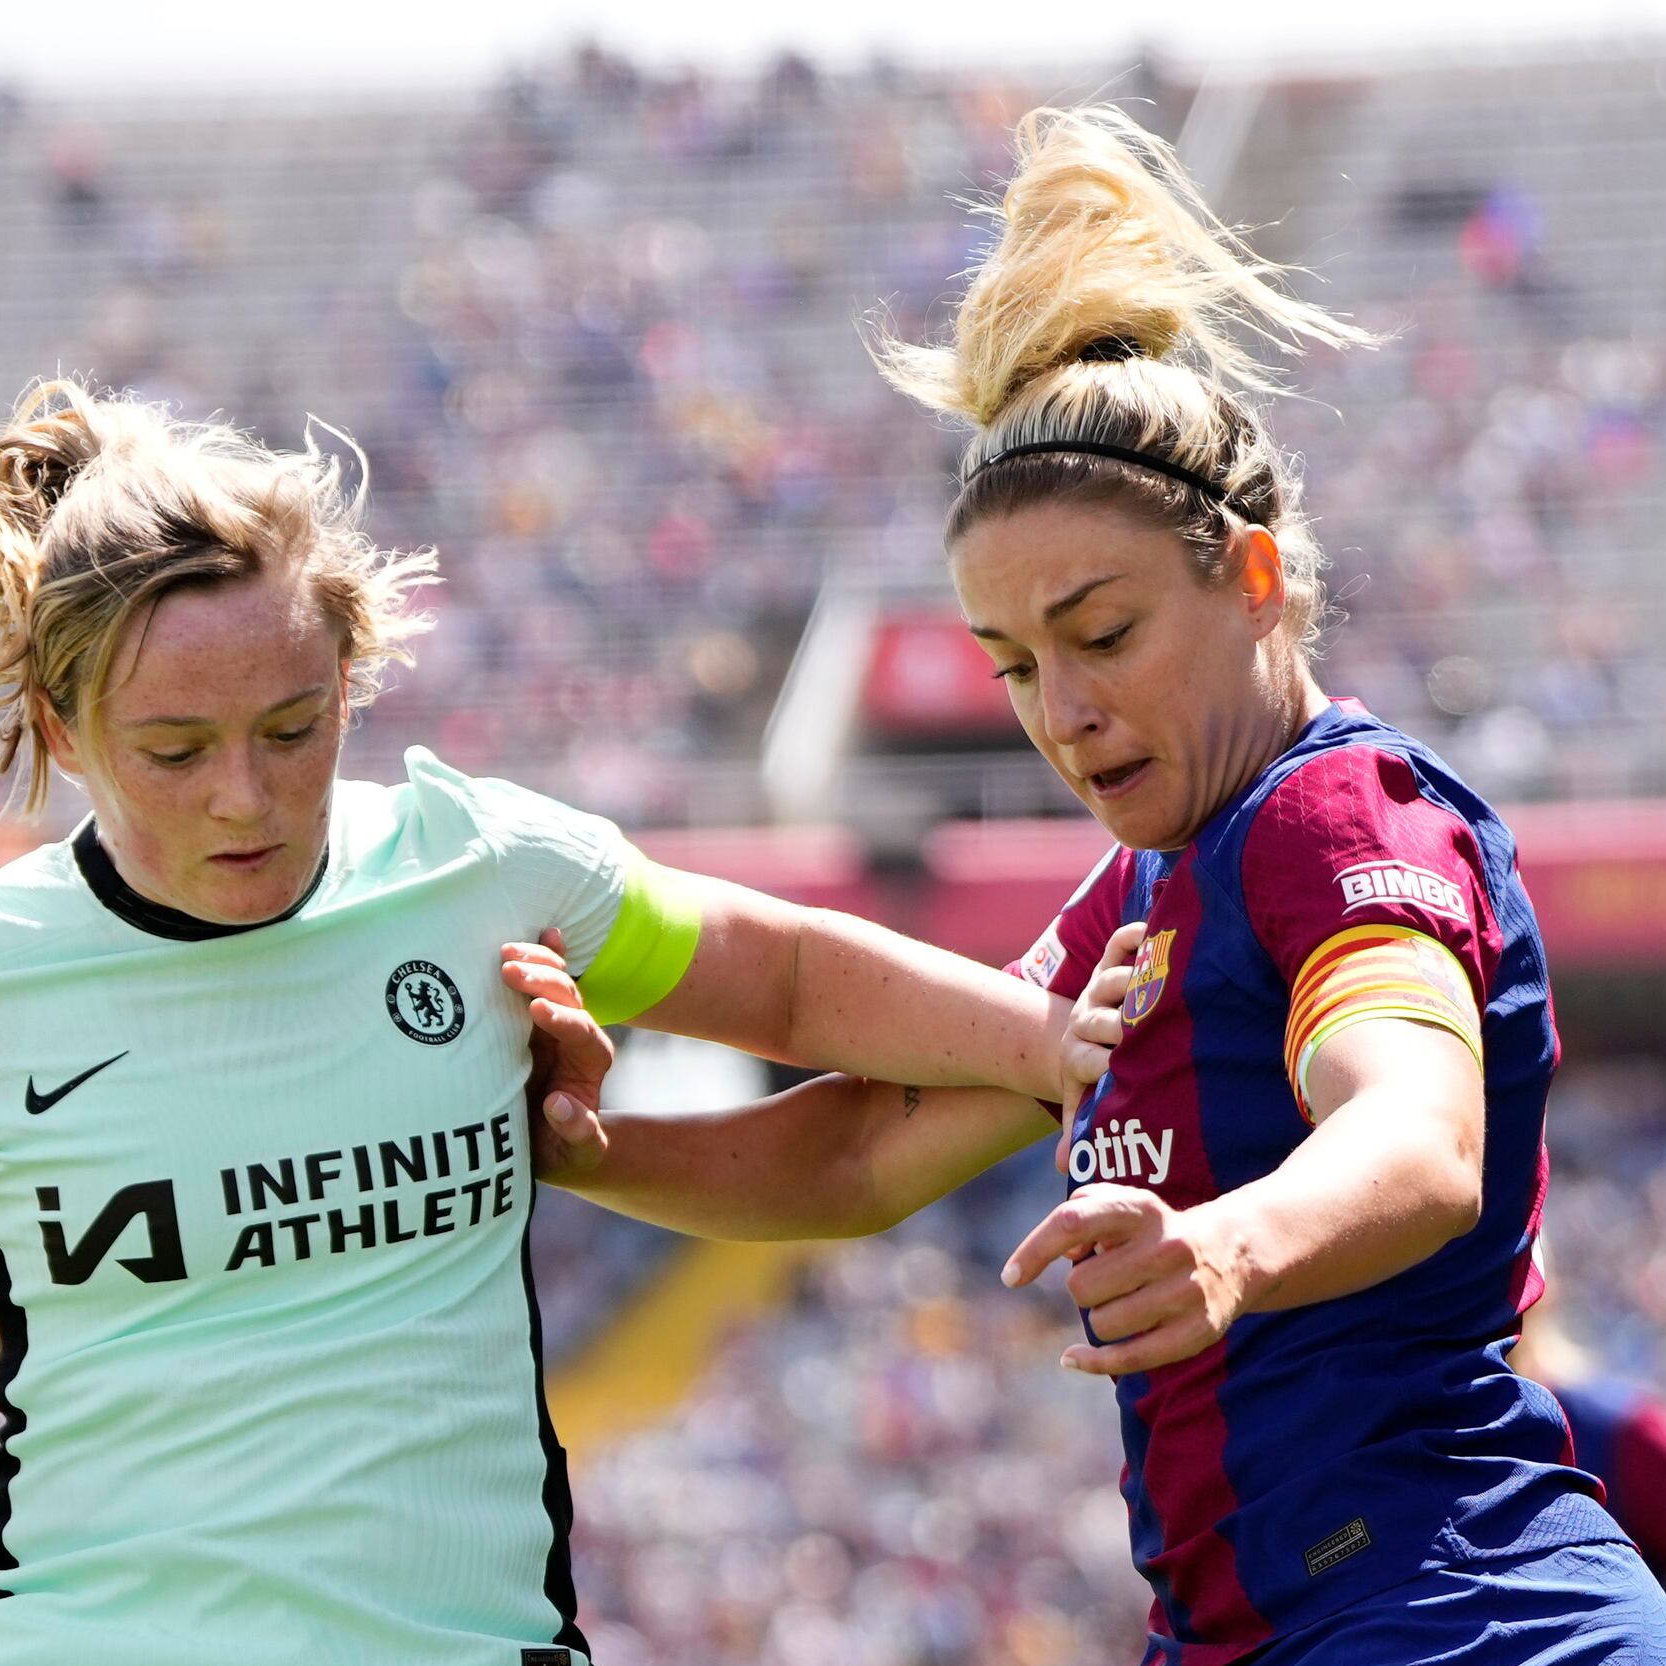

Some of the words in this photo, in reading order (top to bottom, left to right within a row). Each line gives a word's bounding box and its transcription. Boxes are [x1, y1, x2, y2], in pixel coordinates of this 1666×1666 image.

[1341, 868, 1469, 918] BIMBO
[391, 962, 441, 984] CHELSEA
[408, 1029, 446, 1043] FOOTBALL
[446, 1022, 461, 1039] CLUB
[220, 1112, 514, 1216] INFINITE
[1068, 1118, 1174, 1185] otify
[223, 1167, 514, 1272] ATHLETE
